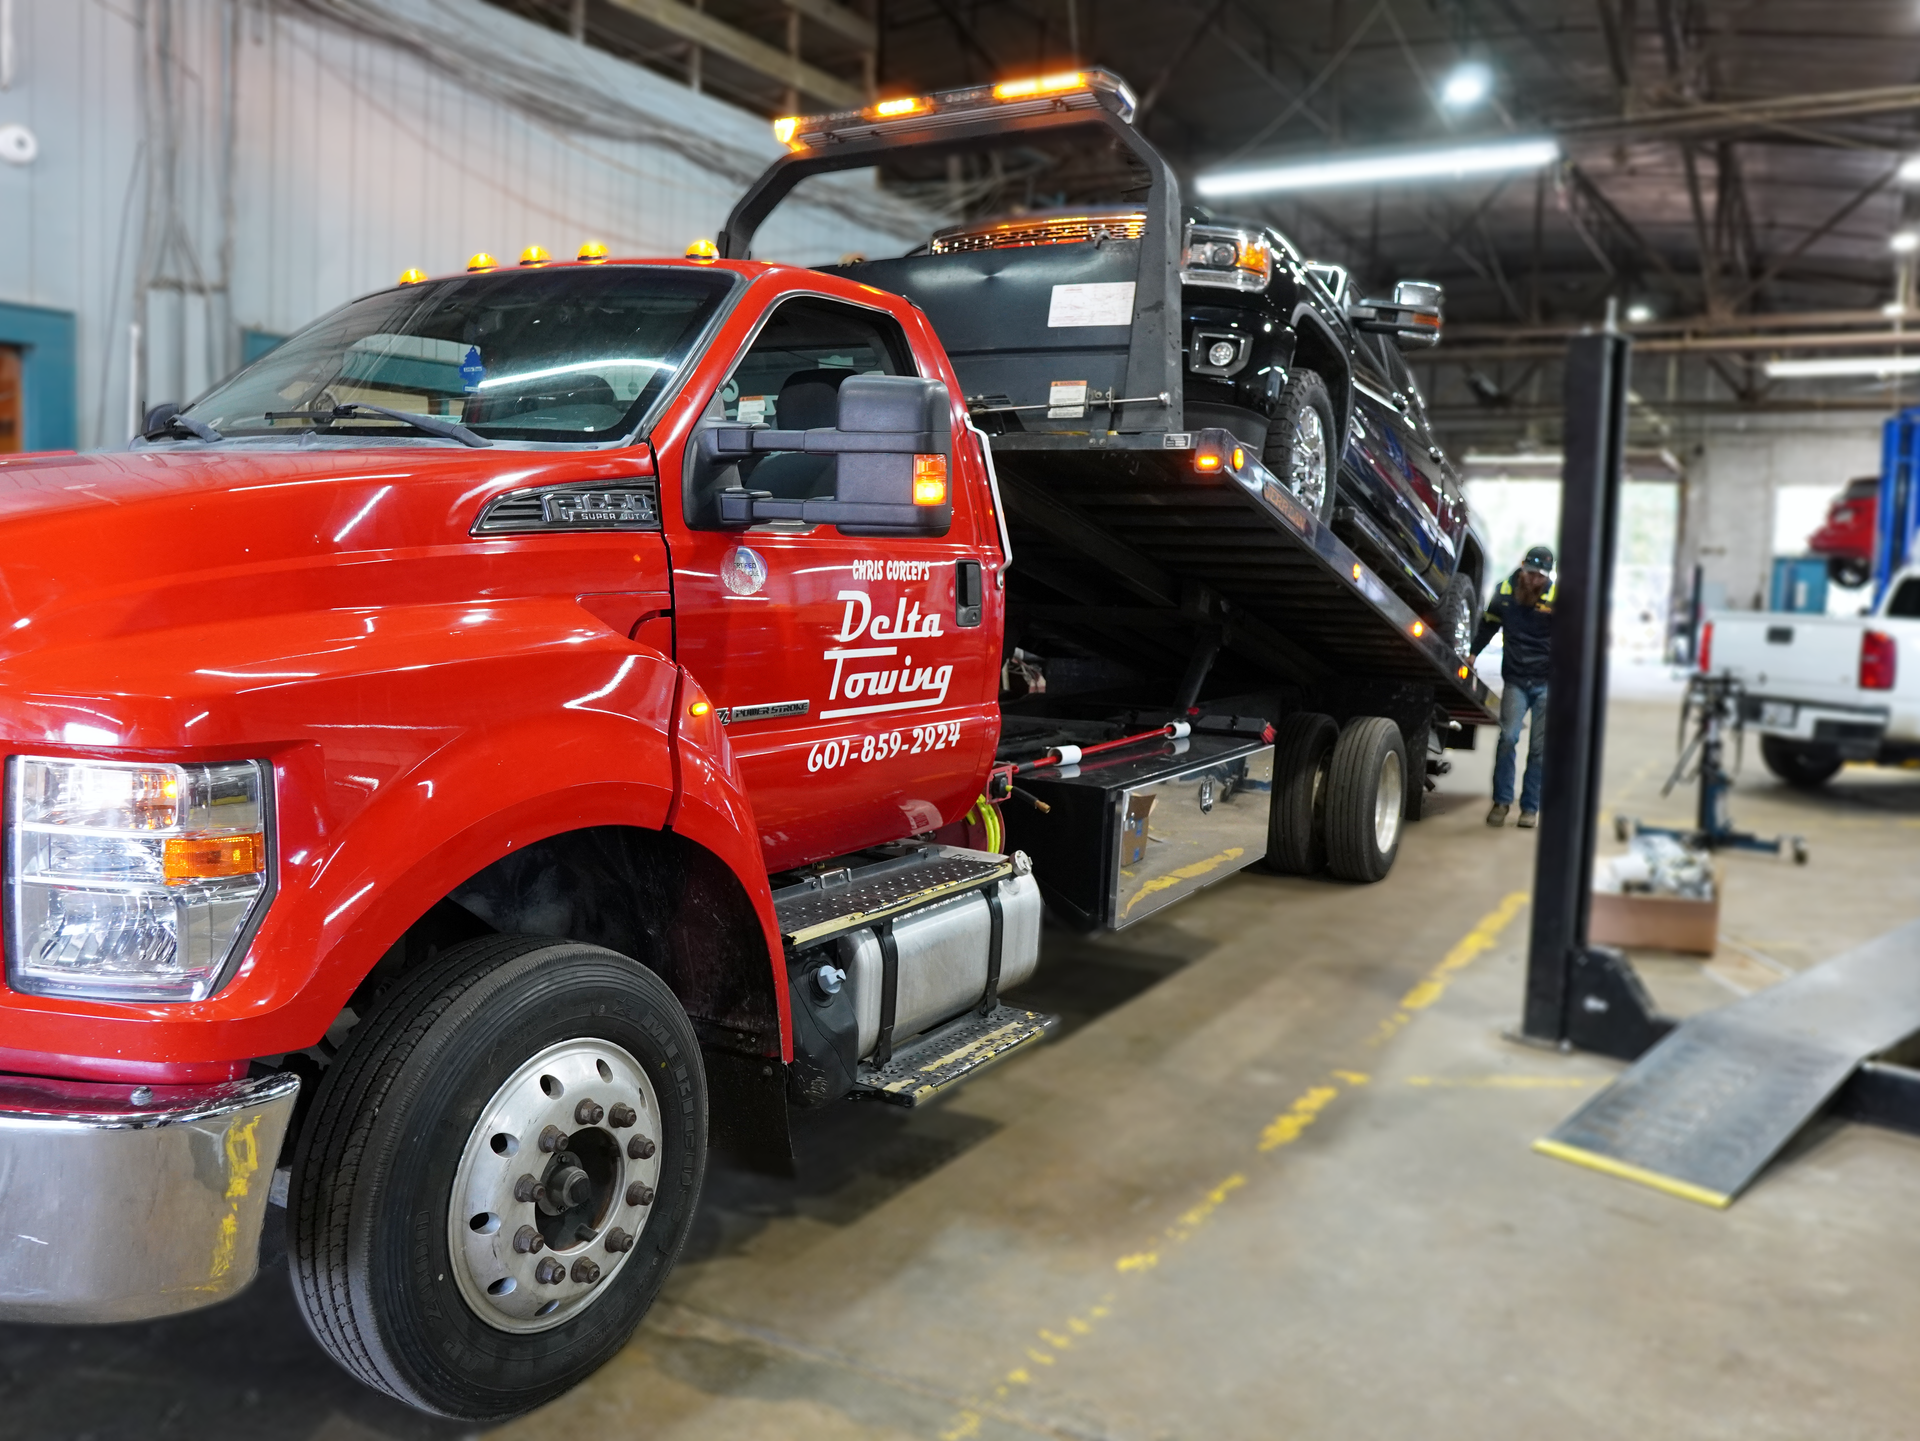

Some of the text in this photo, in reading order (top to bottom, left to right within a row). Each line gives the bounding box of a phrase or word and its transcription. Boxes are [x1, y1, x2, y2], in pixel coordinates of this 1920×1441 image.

[580, 512, 649, 521] SUPER DUTY
[852, 559, 930, 582] CHRIS CORLEY'S
[836, 590, 944, 643] Delta
[820, 647, 954, 720] Towing
[735, 706, 770, 719] POWER
[771, 702, 808, 715] STROKE
[806, 722, 961, 773] 601-859-2924
[415, 1210, 484, 1373] AP 2000
